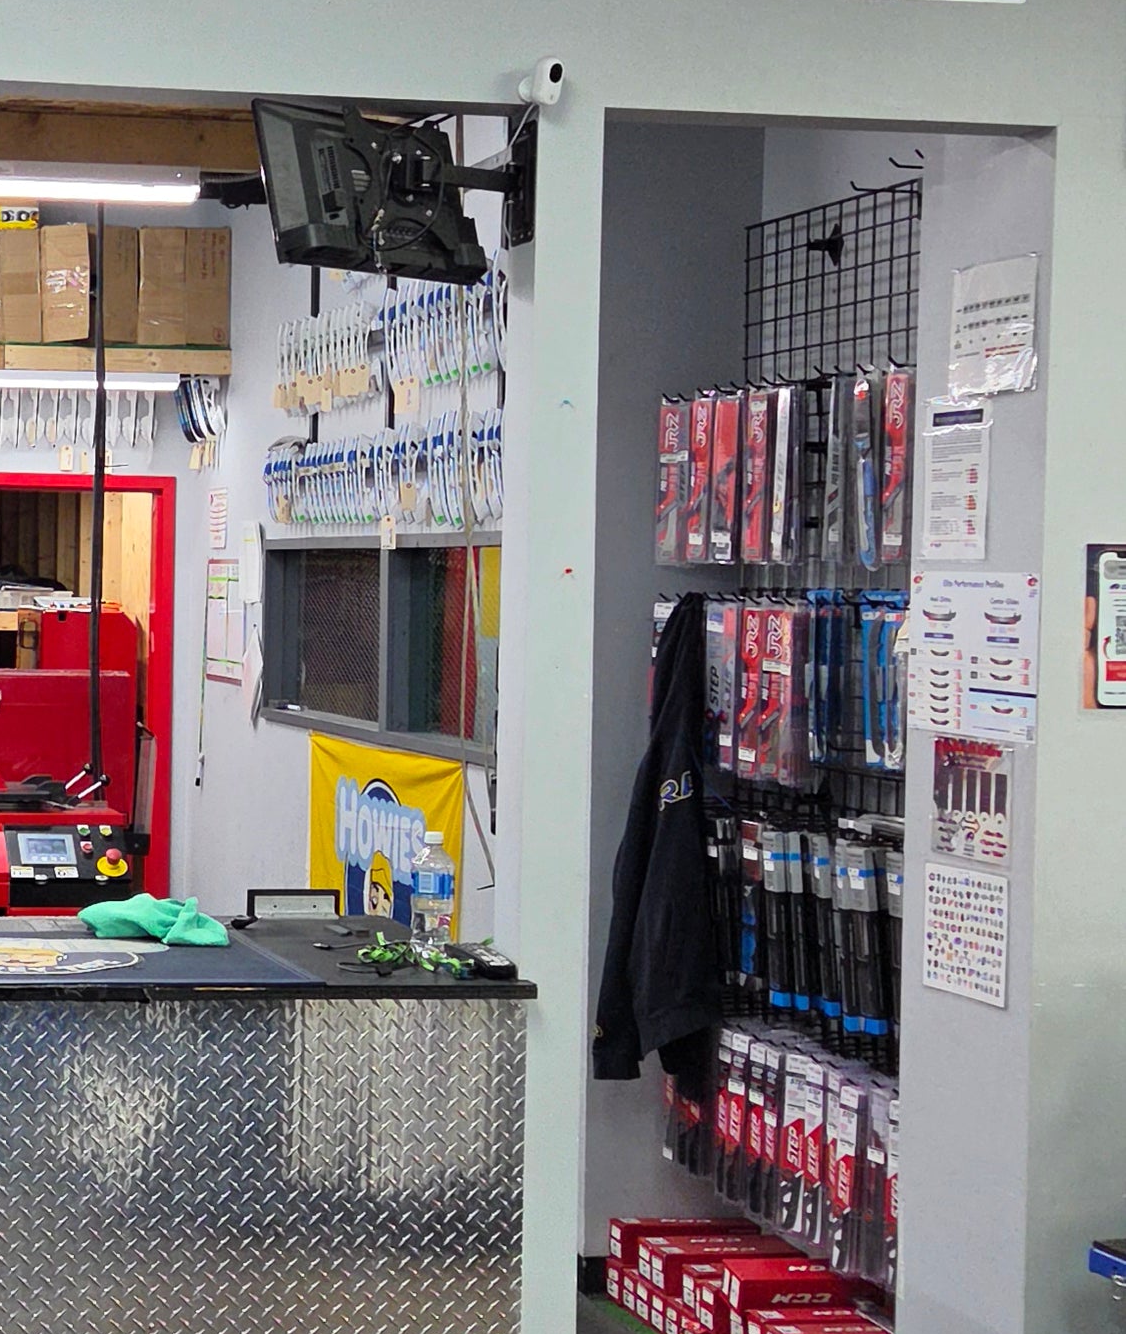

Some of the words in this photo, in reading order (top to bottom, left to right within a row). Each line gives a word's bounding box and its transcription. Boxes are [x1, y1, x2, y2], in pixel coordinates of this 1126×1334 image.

[709, 664, 720, 708] STEP
[339, 785, 427, 872] HOWIES
[729, 1100, 741, 1144] STEP
[750, 1111, 762, 1151] STEP
[786, 1124, 802, 1168] STEP
[806, 1135, 820, 1177] STEP
[838, 1159, 853, 1203] STEP
[770, 1292, 833, 1305] CCM
